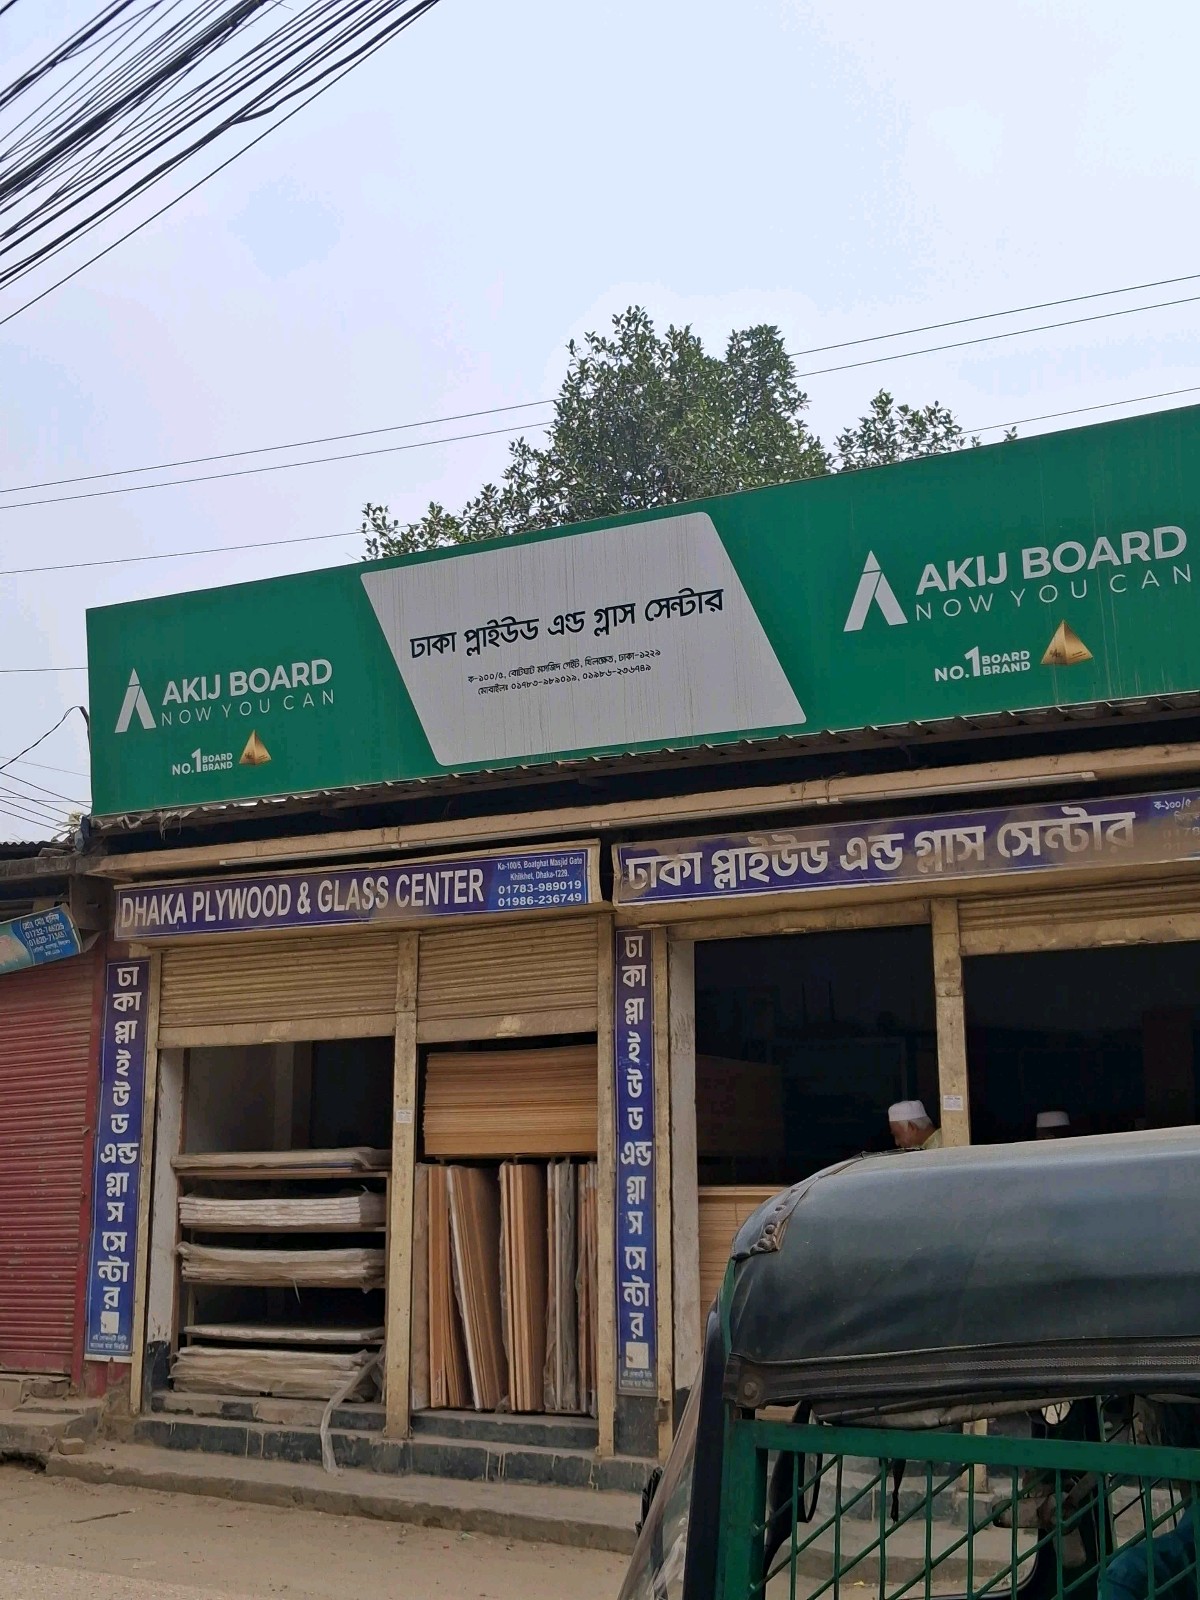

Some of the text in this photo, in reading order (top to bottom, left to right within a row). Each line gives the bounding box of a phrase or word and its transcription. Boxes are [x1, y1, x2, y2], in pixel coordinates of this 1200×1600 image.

[916, 525, 1187, 595] AKIJ BOARD
[916, 563, 1192, 621] NOW YOU CAN
[410, 587, 724, 658] ঢাকা প্লাইউড এন্ড গ্লাস সেন্টার
[982, 650, 1030, 664] BOARD
[982, 661, 1030, 676] BRAND
[162, 659, 333, 705] AKIJ BOARD
[162, 689, 335, 727] NOW YOU CAN
[202, 752, 233, 763] BOARD
[202, 761, 233, 772] BRAND
[626, 806, 1136, 890] ঢাকা প্লাইউড এন্ড গ্লাস সেন্টার
[550, 858, 568, 868] Masjid
[120, 868, 485, 928] DHAKA PLYWOOD & GLASS CENTER
[498, 880, 582, 895] 01783-989019
[498, 893, 582, 907] 01986-236749
[100, 1142, 140, 1165] এন্ড
[620, 1141, 653, 1167] এন্ড
